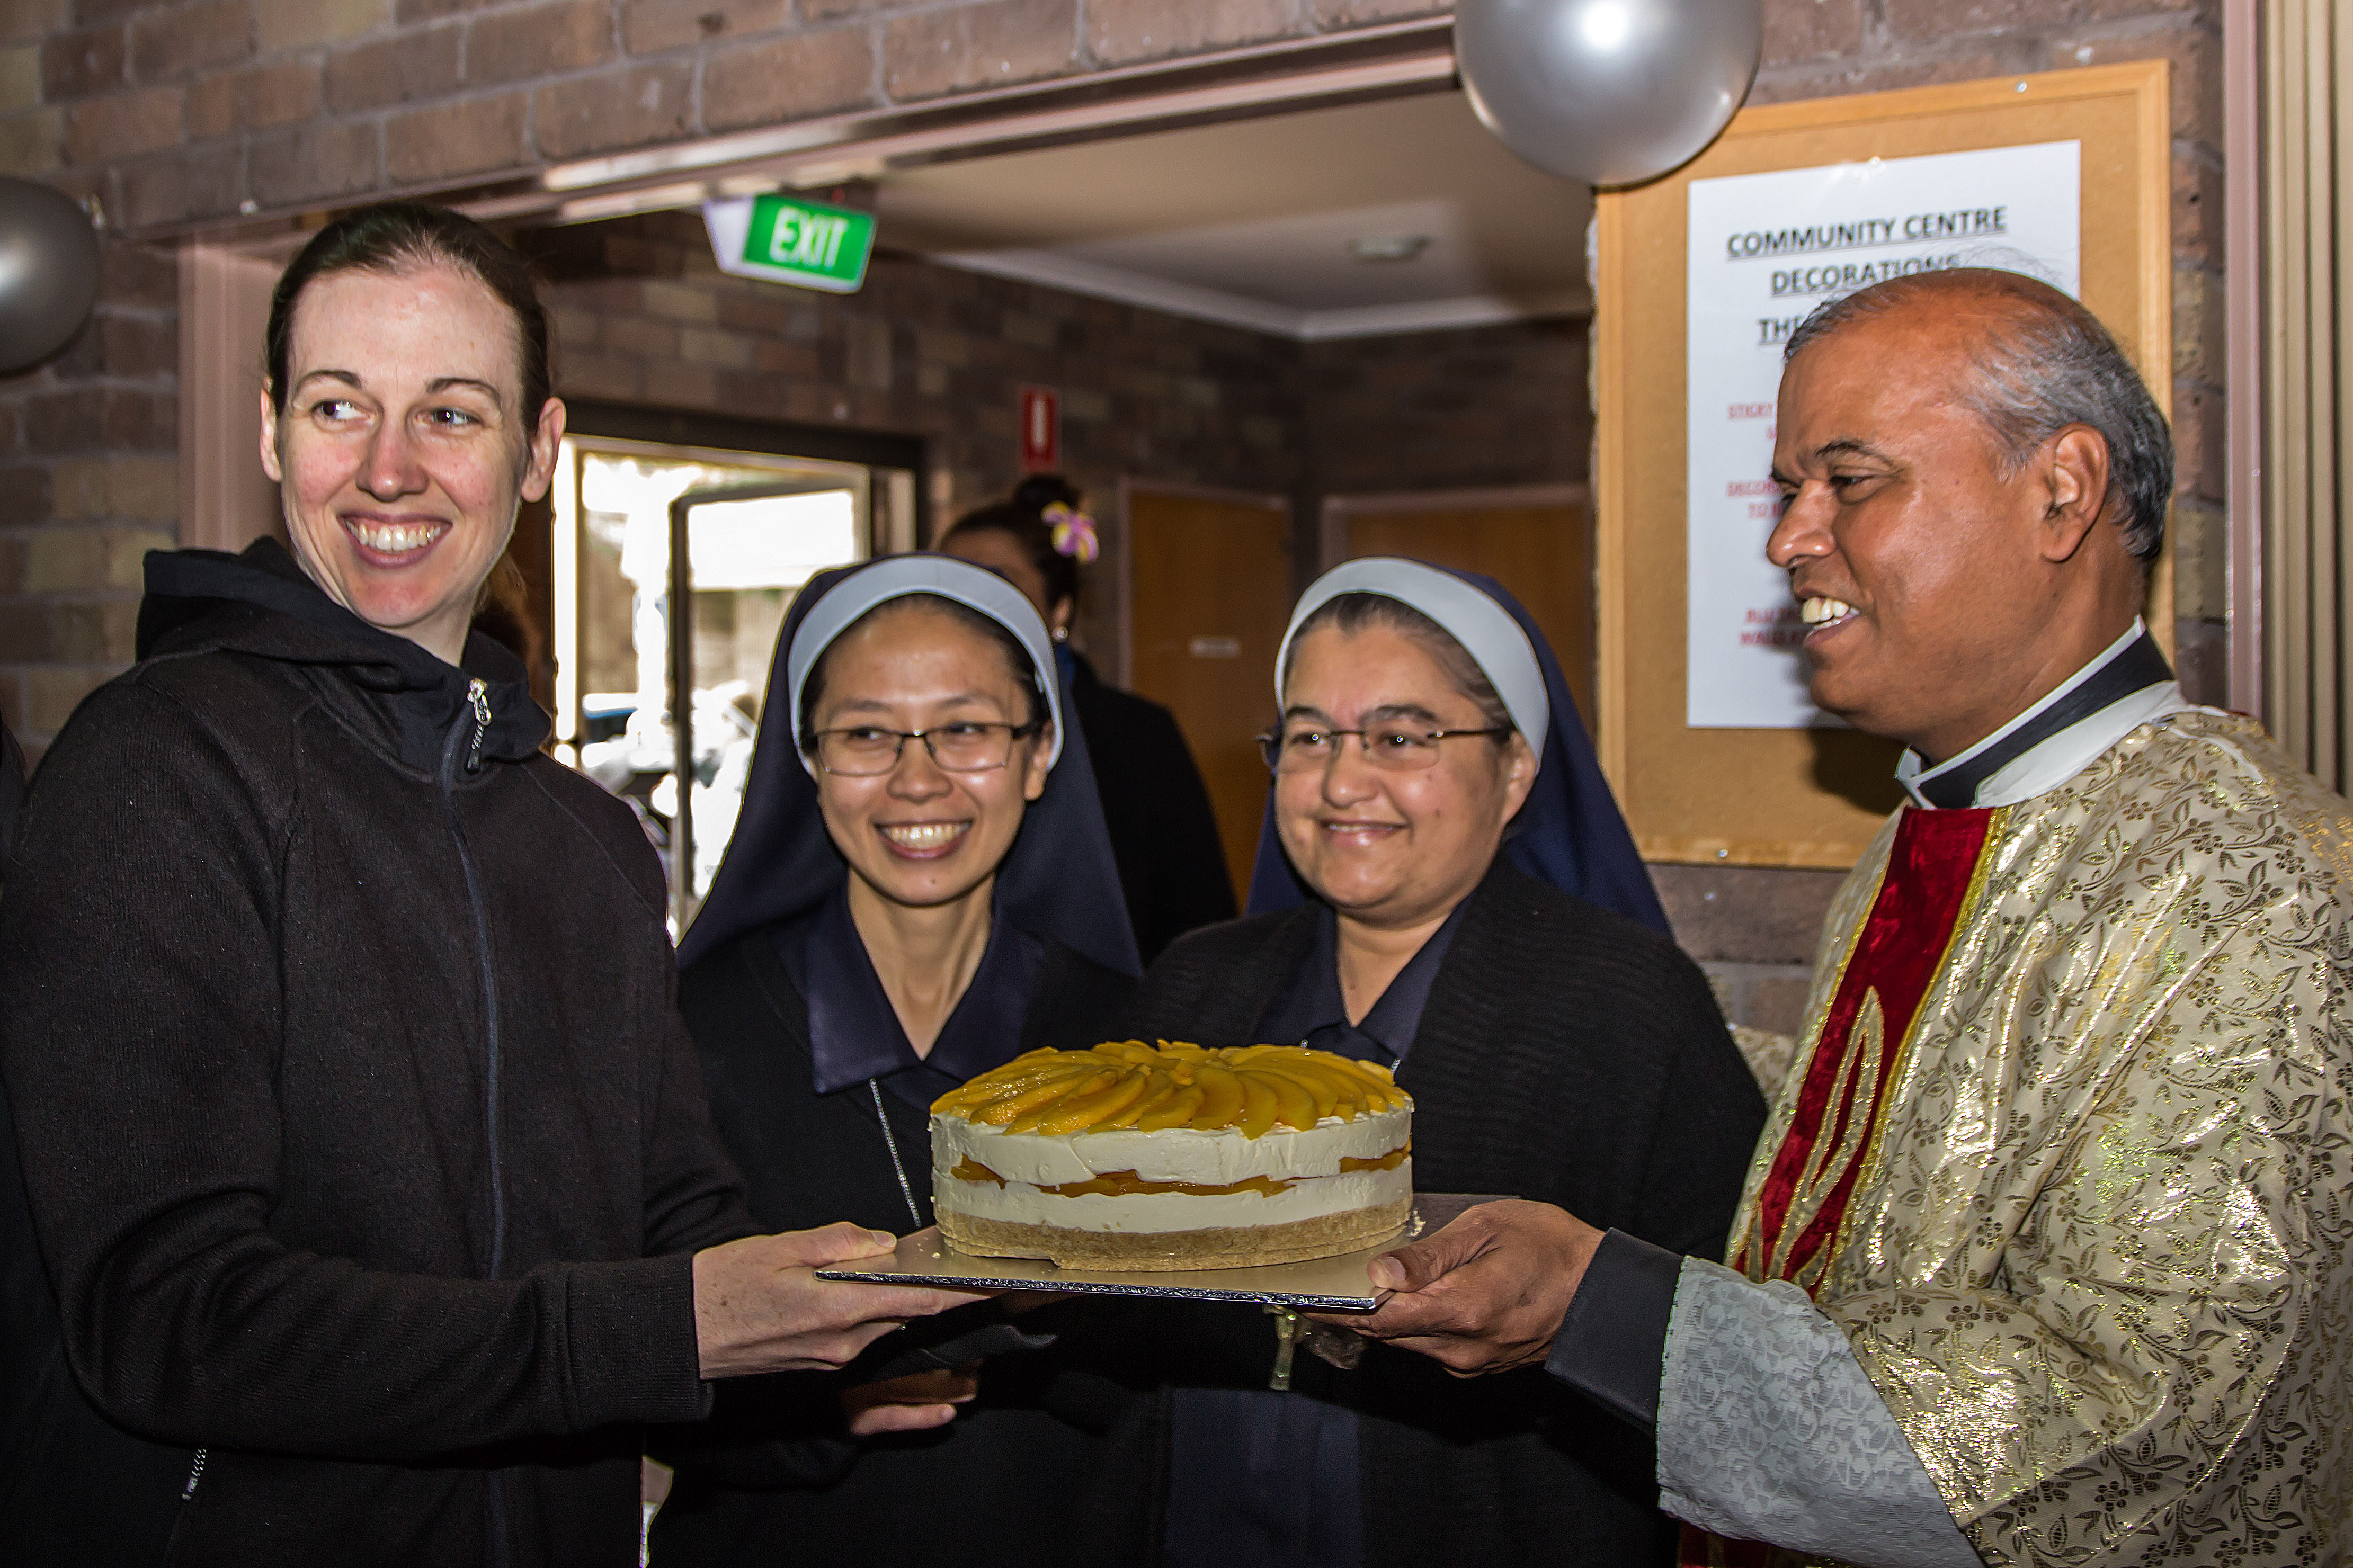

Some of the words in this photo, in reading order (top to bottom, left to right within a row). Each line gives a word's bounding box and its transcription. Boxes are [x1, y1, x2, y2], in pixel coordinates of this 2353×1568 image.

[769, 205, 849, 271] EXIT
[1727, 218, 1896, 258] COMMUNITY
[1904, 206, 2008, 240] CENTRE
